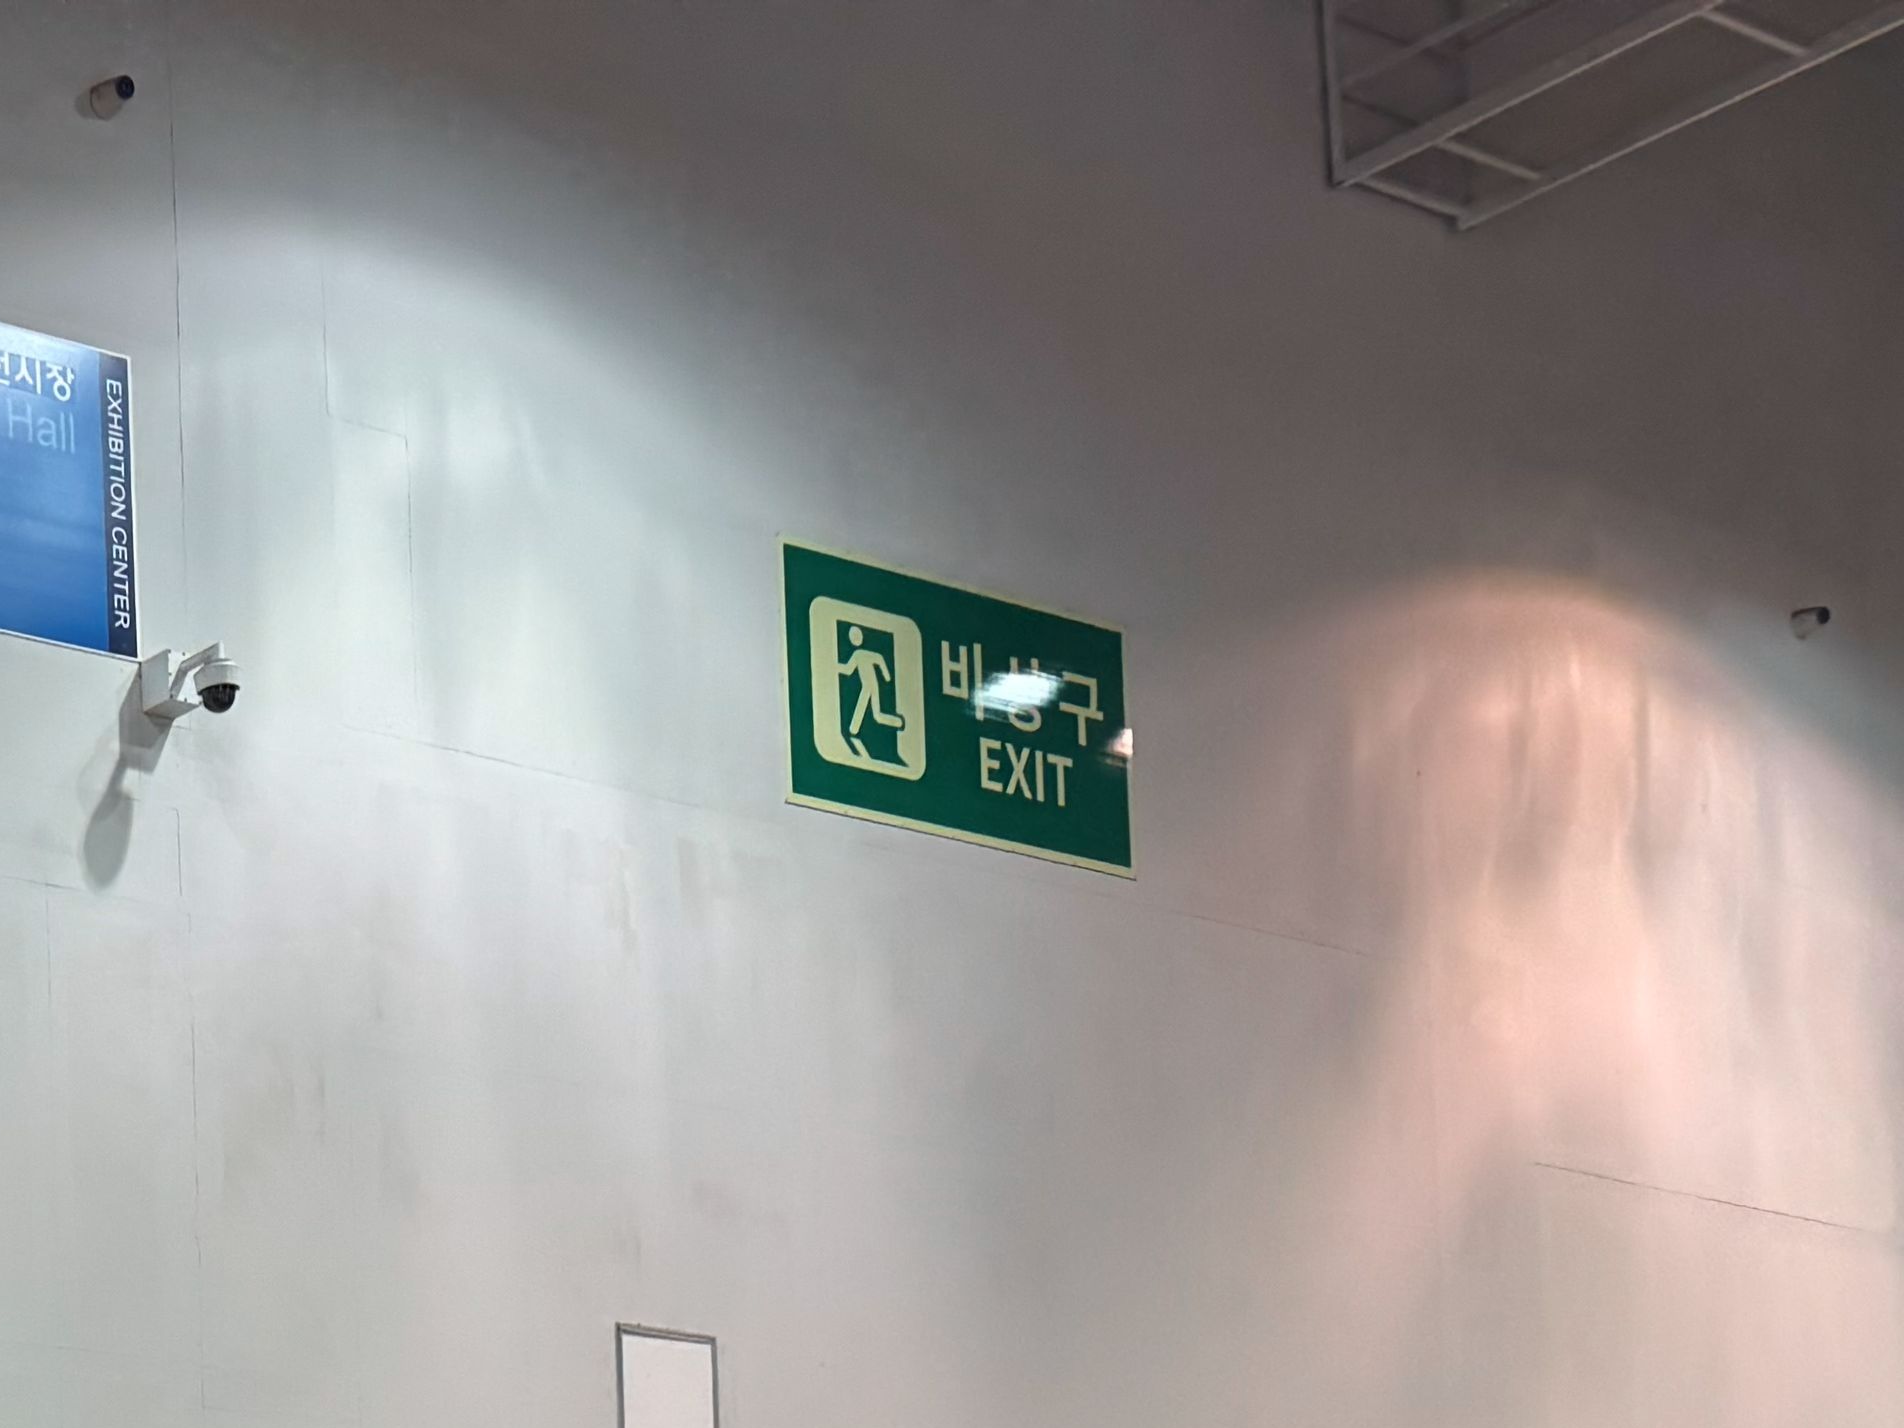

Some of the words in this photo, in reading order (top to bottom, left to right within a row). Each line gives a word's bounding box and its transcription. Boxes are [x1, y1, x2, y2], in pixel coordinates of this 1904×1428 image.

[7, 398, 75, 454] Hall
[105, 378, 127, 521] EXHIBITION
[111, 525, 130, 630] CENTER
[979, 735, 1073, 808] EXIT
